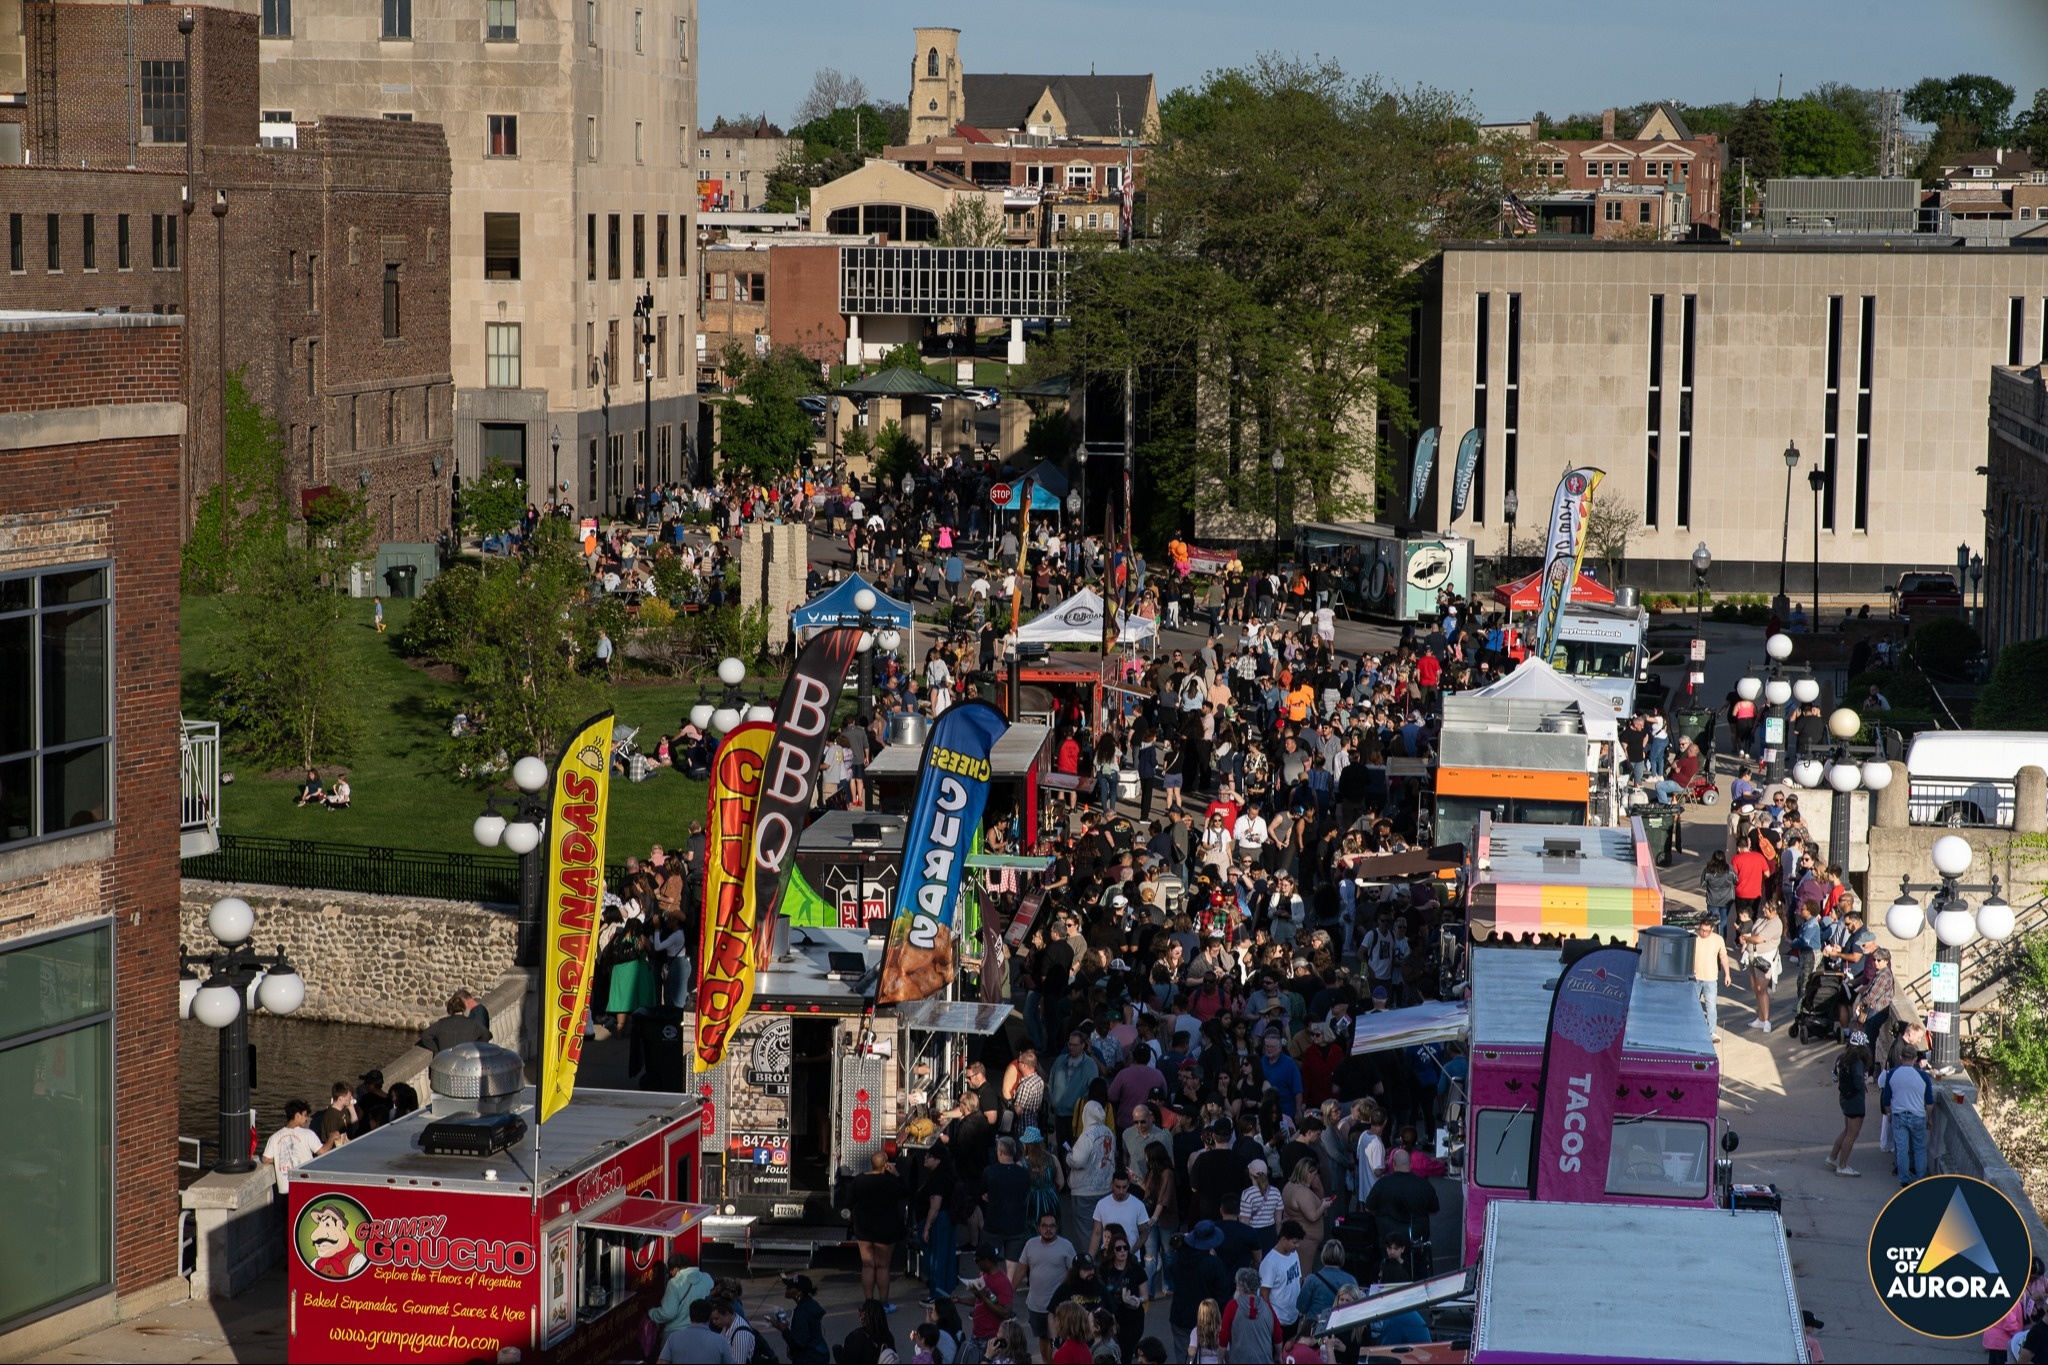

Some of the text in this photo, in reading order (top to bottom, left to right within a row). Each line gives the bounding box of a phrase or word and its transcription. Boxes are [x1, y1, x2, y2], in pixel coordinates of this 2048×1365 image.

[992, 489, 1011, 499] STOP
[1457, 454, 1478, 510] LEMONADE
[756, 673, 830, 872] BBQ
[699, 748, 765, 1065] CHURROS
[759, 1031, 775, 1057] AWARD
[755, 1073, 789, 1083] BROT
[1559, 1073, 1592, 1173] TACOS
[742, 1134, 789, 1148] 847-87
[355, 1214, 448, 1240] GRUMPY
[365, 1236, 536, 1275] GAUCHO
[374, 1266, 522, 1292] Explore the Flavors of Argentina
[303, 1291, 526, 1322] Baked Empanadas, Gourmet Sauces & More
[329, 1326, 500, 1352] www.grumpygaucho.com
